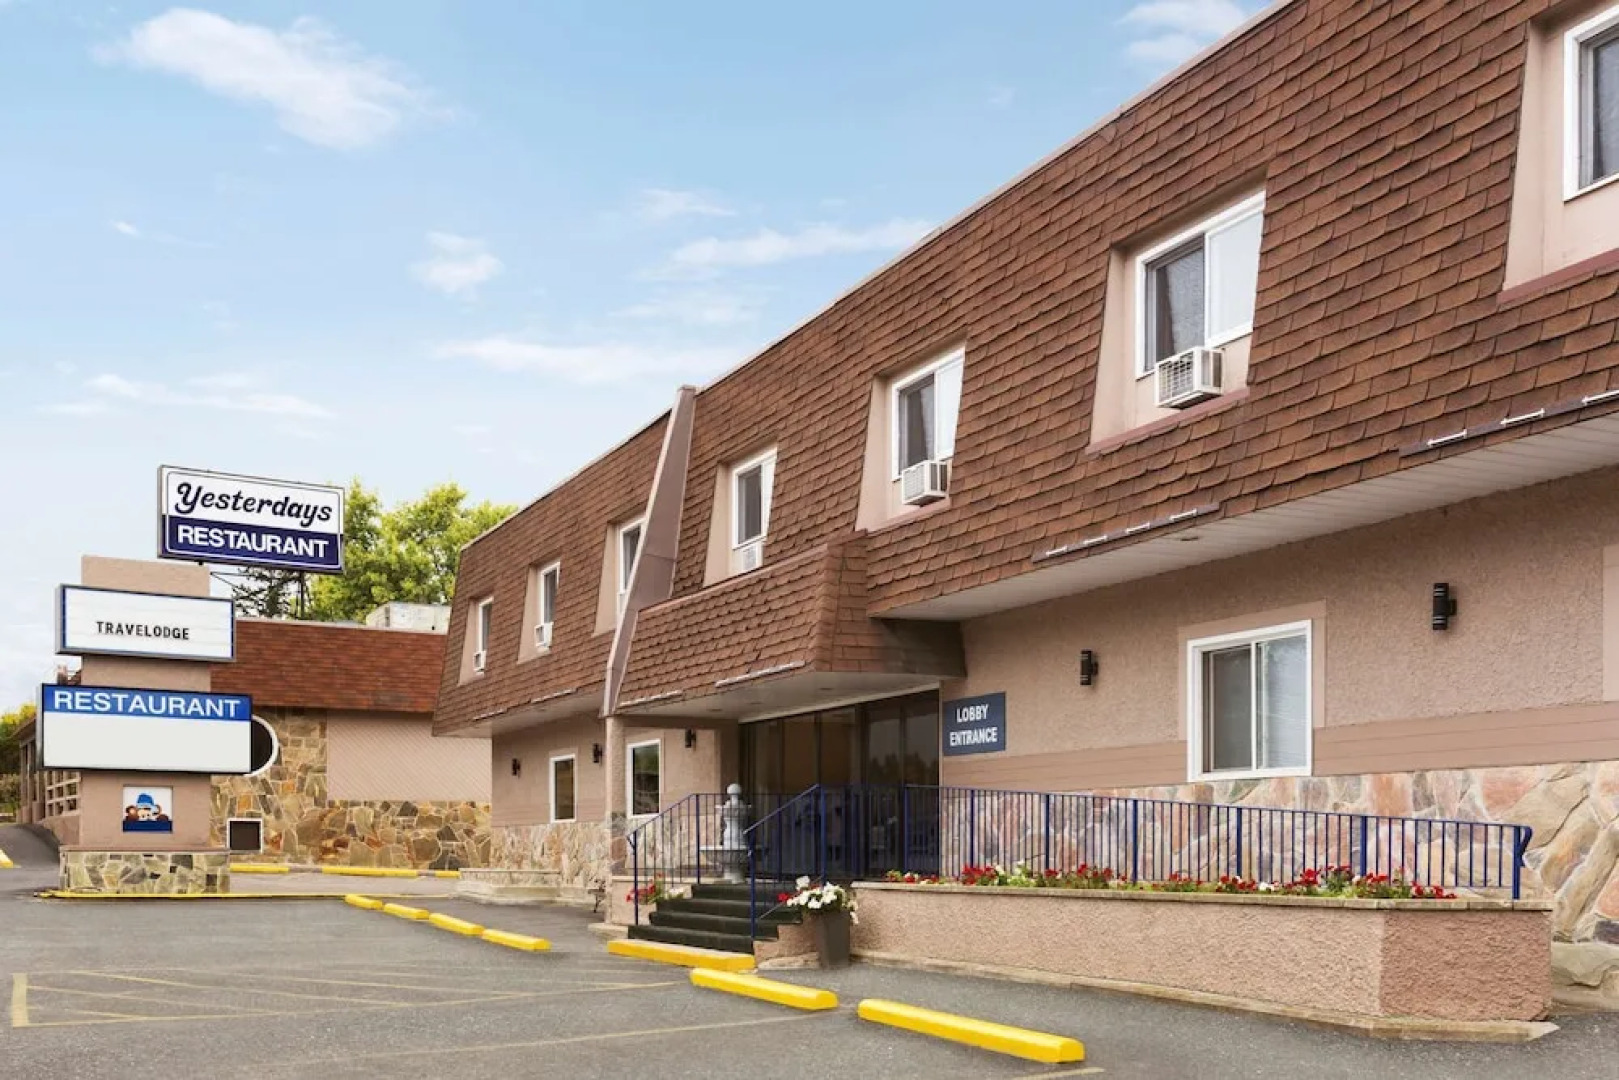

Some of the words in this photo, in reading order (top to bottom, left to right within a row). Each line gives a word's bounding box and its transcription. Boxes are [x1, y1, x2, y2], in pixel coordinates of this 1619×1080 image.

[174, 482, 332, 527] Yesterdays
[178, 525, 329, 558] RESTAURANT
[96, 621, 190, 641] TRAVELODGE
[53, 691, 239, 718] RESTAURANT
[956, 704, 989, 723] LOBBY
[949, 727, 998, 746] ENTRANCE
